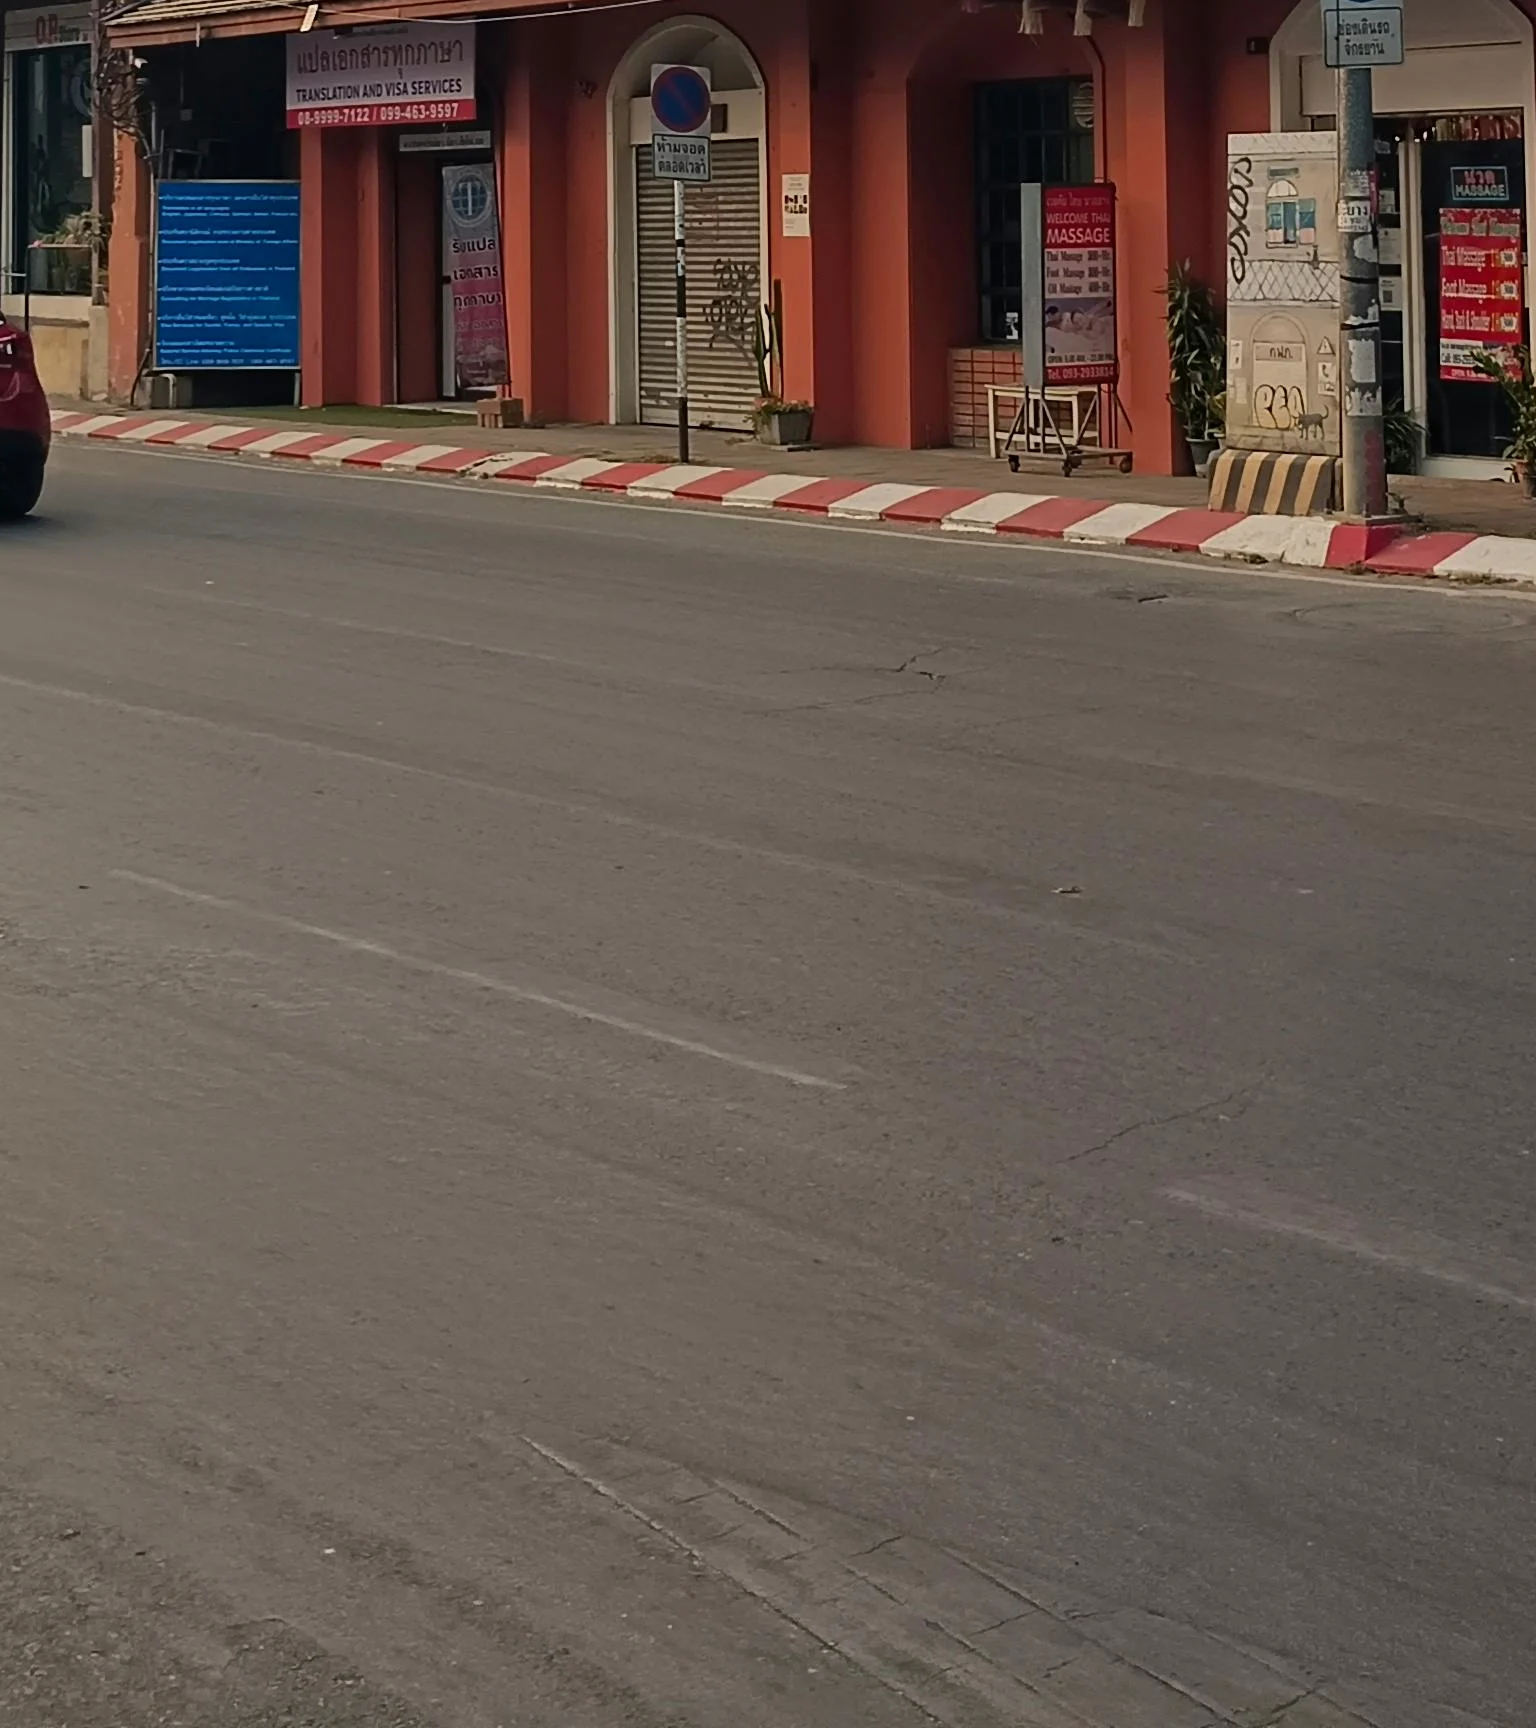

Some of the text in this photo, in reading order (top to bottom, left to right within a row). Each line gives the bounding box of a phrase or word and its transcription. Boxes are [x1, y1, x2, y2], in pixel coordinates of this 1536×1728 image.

[297, 78, 462, 102] TRANSLATION AND VISA SERVICES
[380, 103, 459, 120] 099-463-9597
[657, 136, 705, 154] ห้ามจอด
[1455, 184, 1505, 197] MASSAGE
[1046, 213, 1111, 223] WELCOME THAI
[1046, 228, 1110, 243] MASSAGE
[453, 265, 499, 280] เอกสาร
